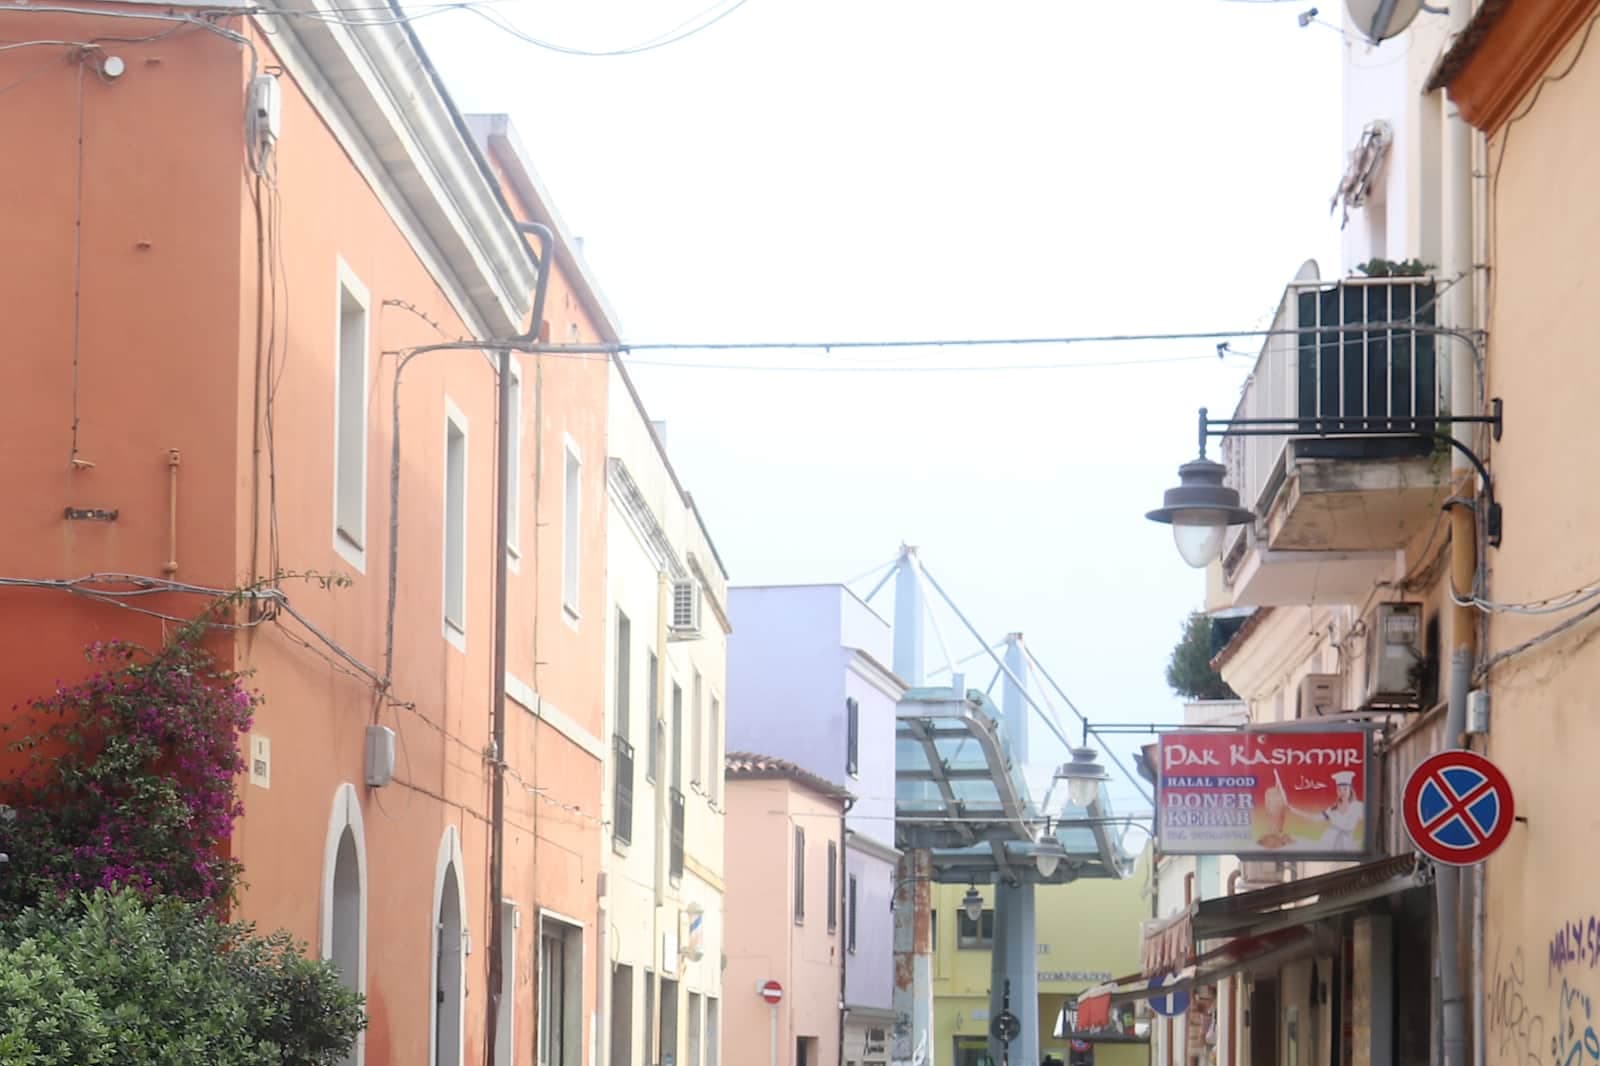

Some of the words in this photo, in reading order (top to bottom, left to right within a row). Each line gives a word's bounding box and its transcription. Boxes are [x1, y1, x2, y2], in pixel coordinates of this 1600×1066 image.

[1167, 776, 1214, 788] HALAL
[1218, 776, 1256, 788] FOOD
[1166, 792, 1255, 809] DONER
